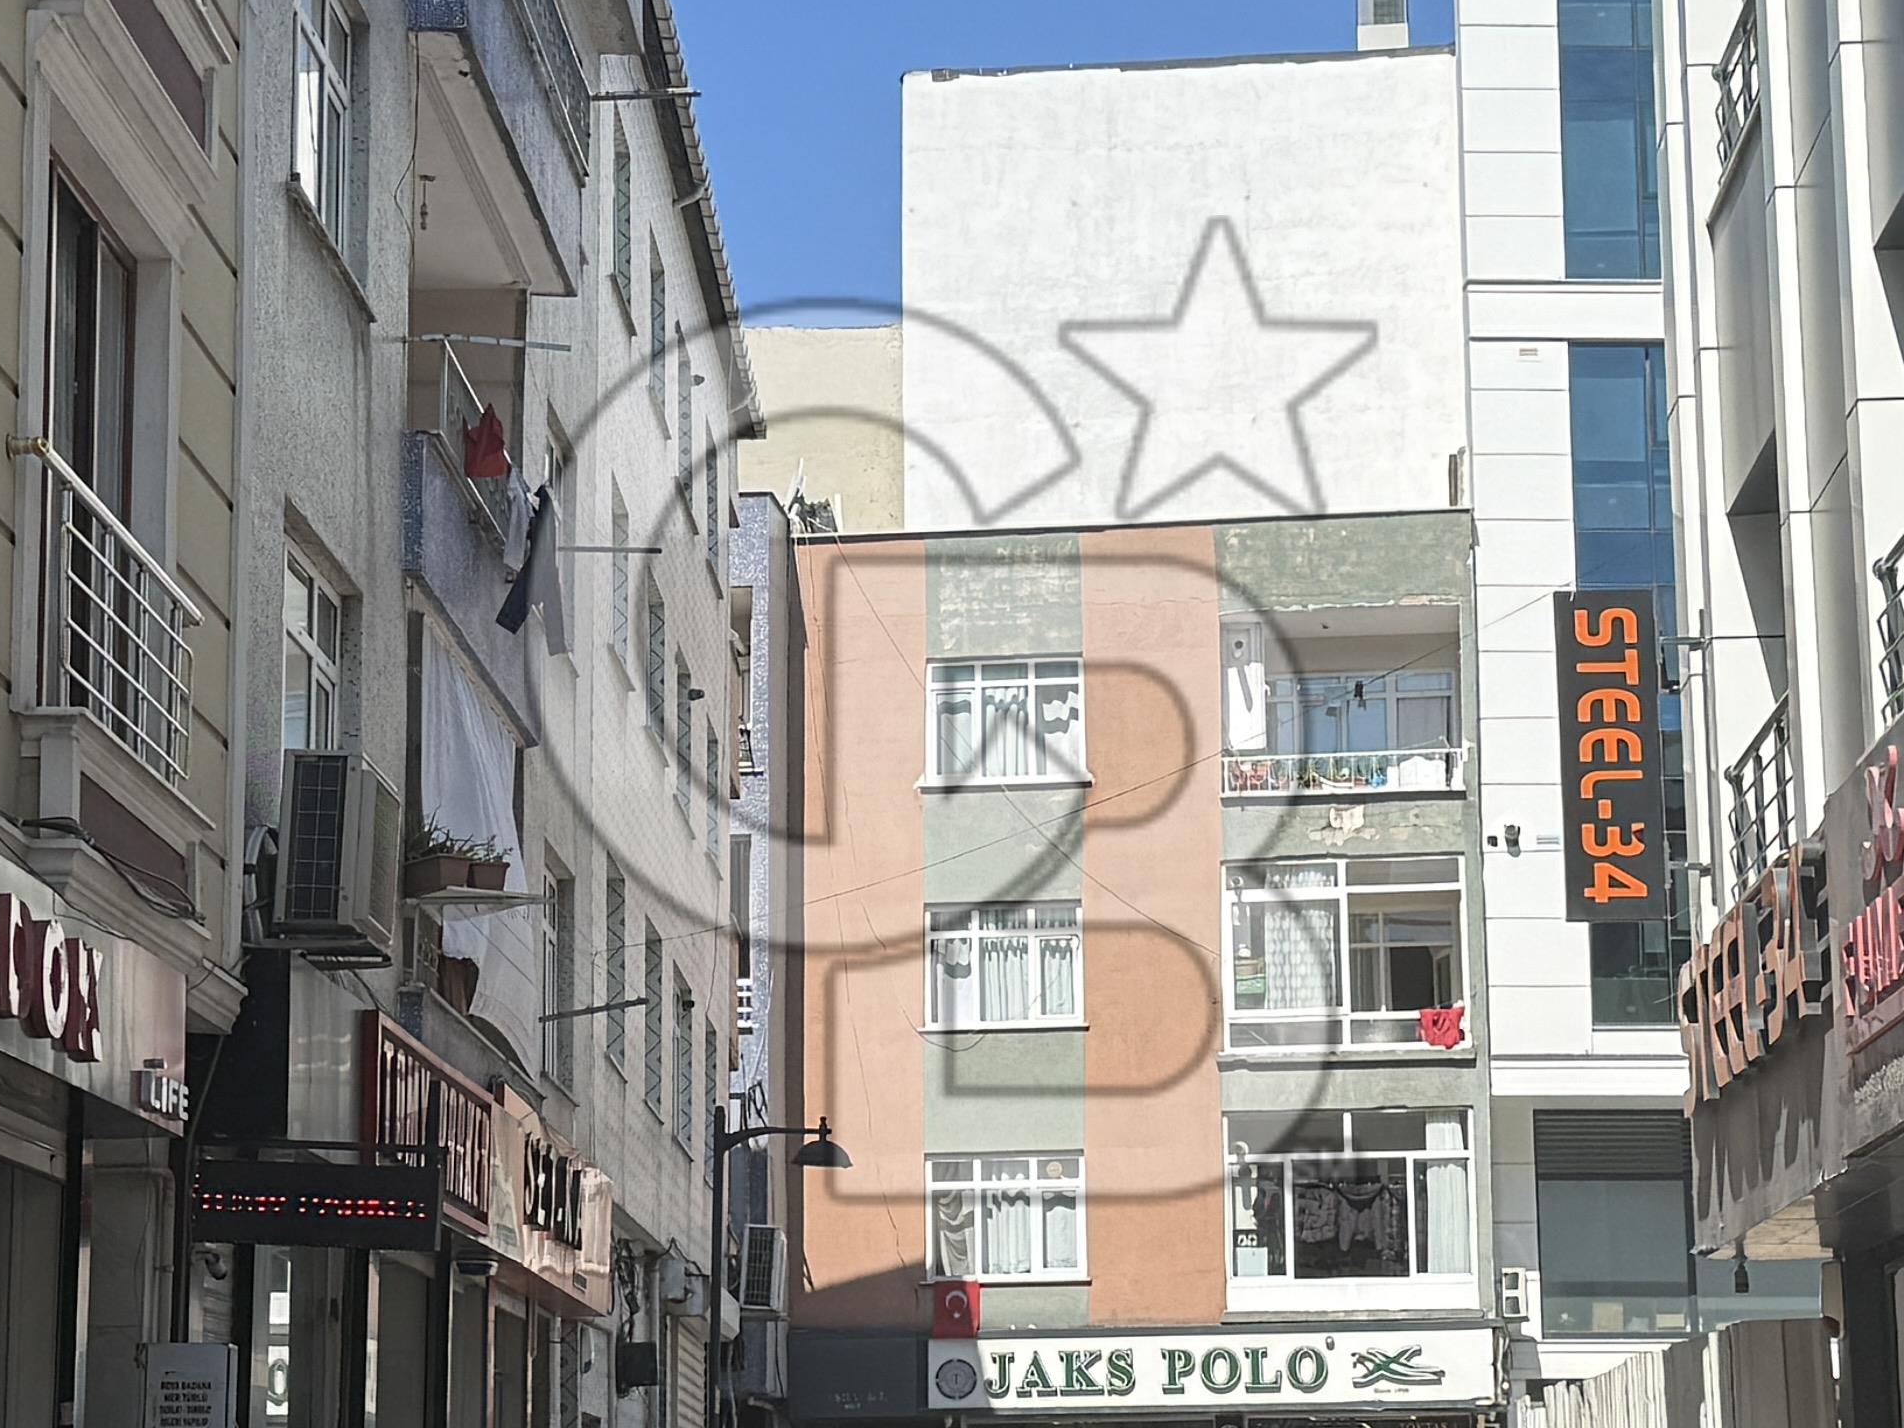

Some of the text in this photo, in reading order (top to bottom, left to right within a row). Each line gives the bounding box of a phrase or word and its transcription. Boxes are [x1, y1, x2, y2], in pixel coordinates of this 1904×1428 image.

[1574, 607, 1648, 903] STEEL-34
[983, 1345, 1329, 1399] JAKS POLO
